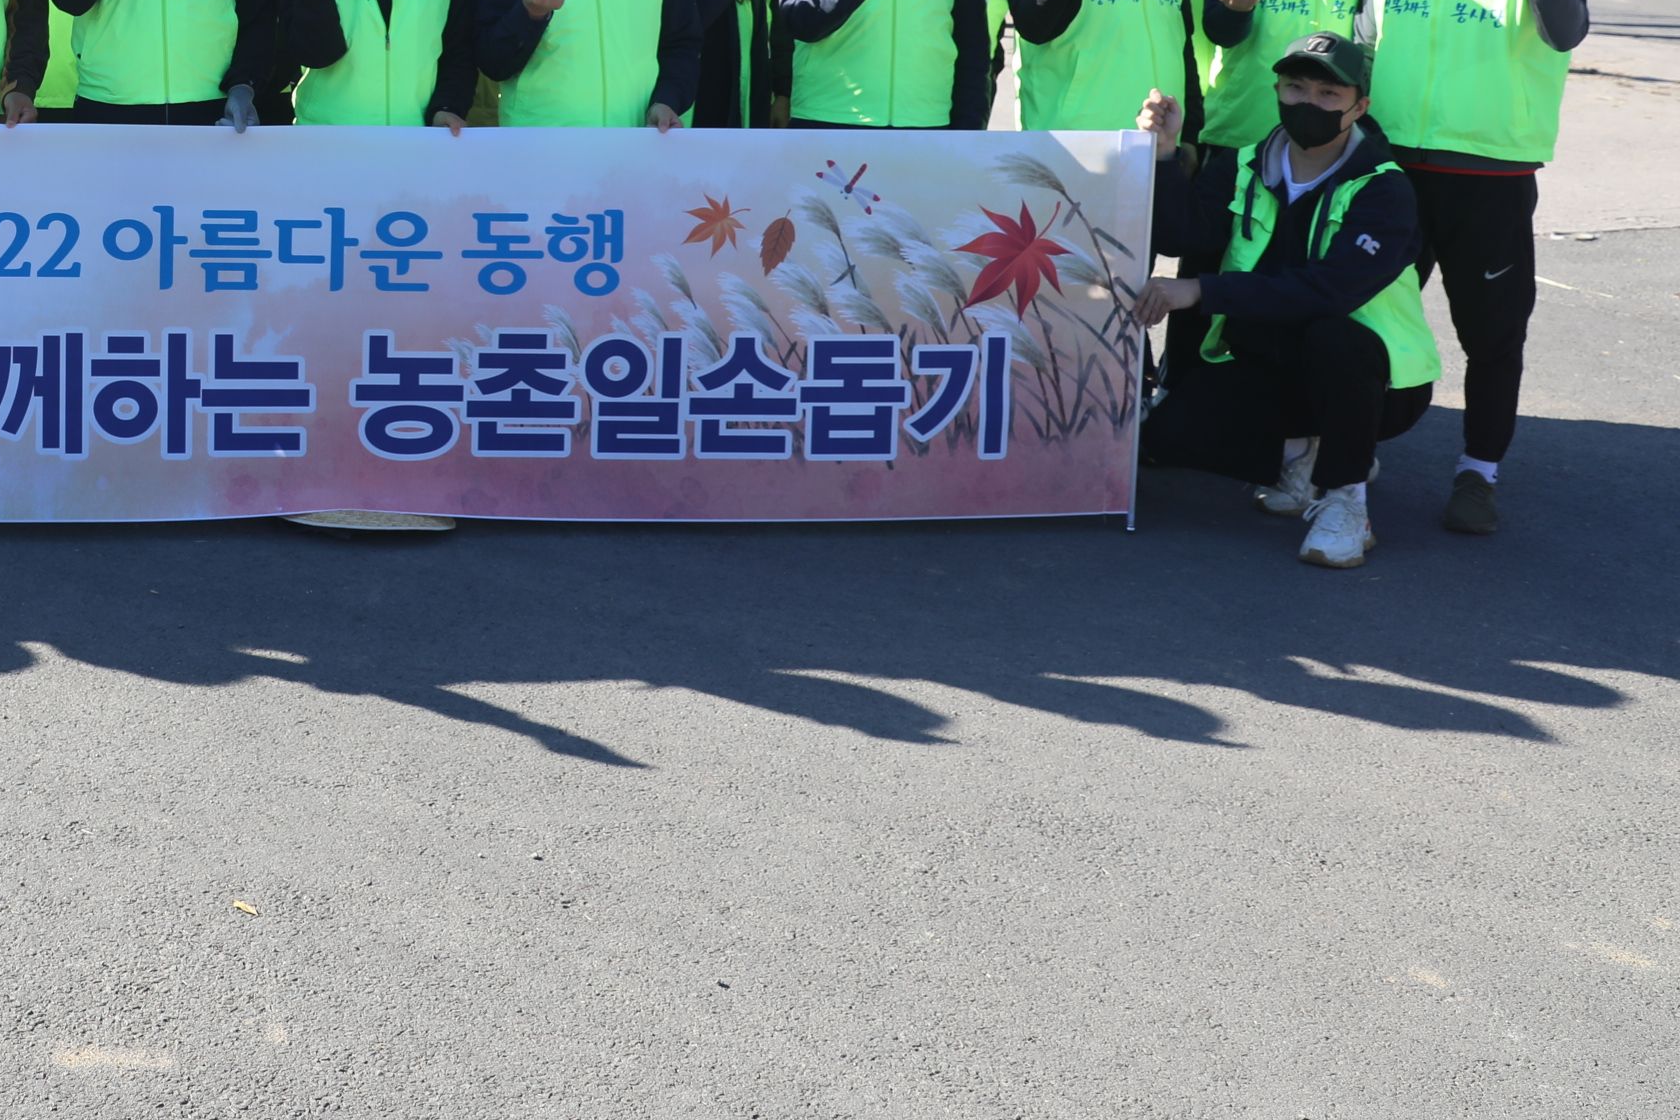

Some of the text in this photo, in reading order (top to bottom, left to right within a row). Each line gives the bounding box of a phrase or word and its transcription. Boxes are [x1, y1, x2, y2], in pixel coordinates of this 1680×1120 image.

[101, 205, 444, 294] 아름다운
[460, 208, 626, 298] 동행
[354, 333, 1008, 457] 농촌일손돕기
